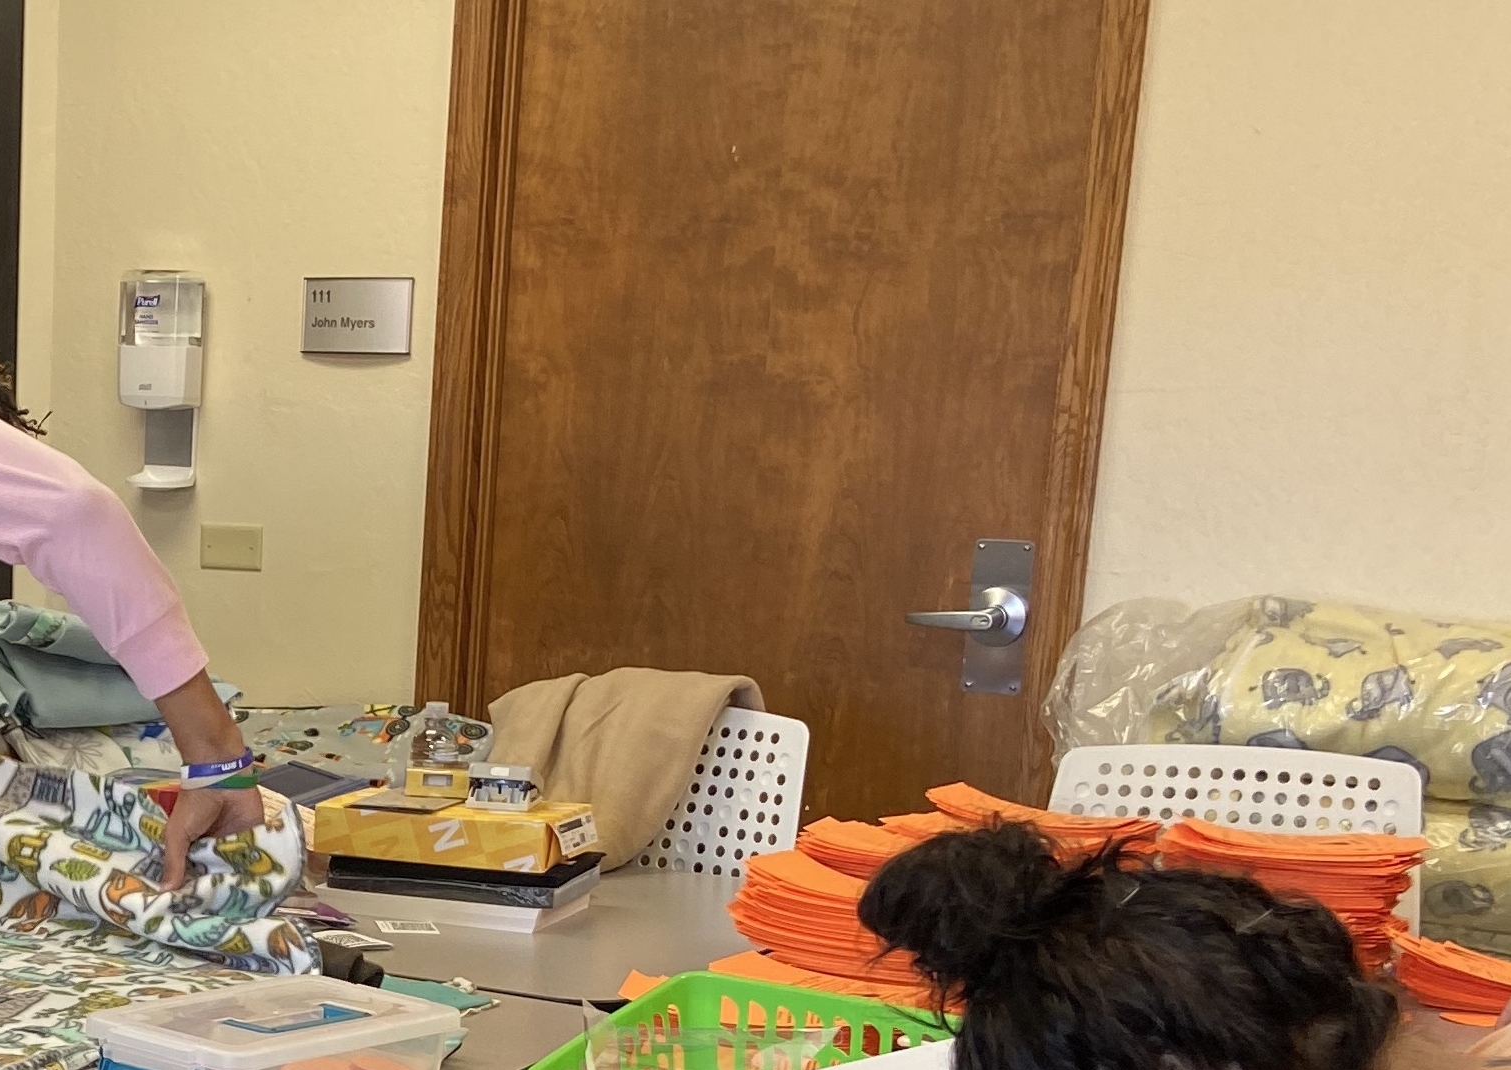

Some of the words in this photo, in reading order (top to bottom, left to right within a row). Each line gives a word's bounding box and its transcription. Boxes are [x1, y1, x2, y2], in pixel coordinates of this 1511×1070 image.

[312, 289, 331, 304] 111
[311, 316, 337, 329] John
[340, 316, 376, 331] Myers
